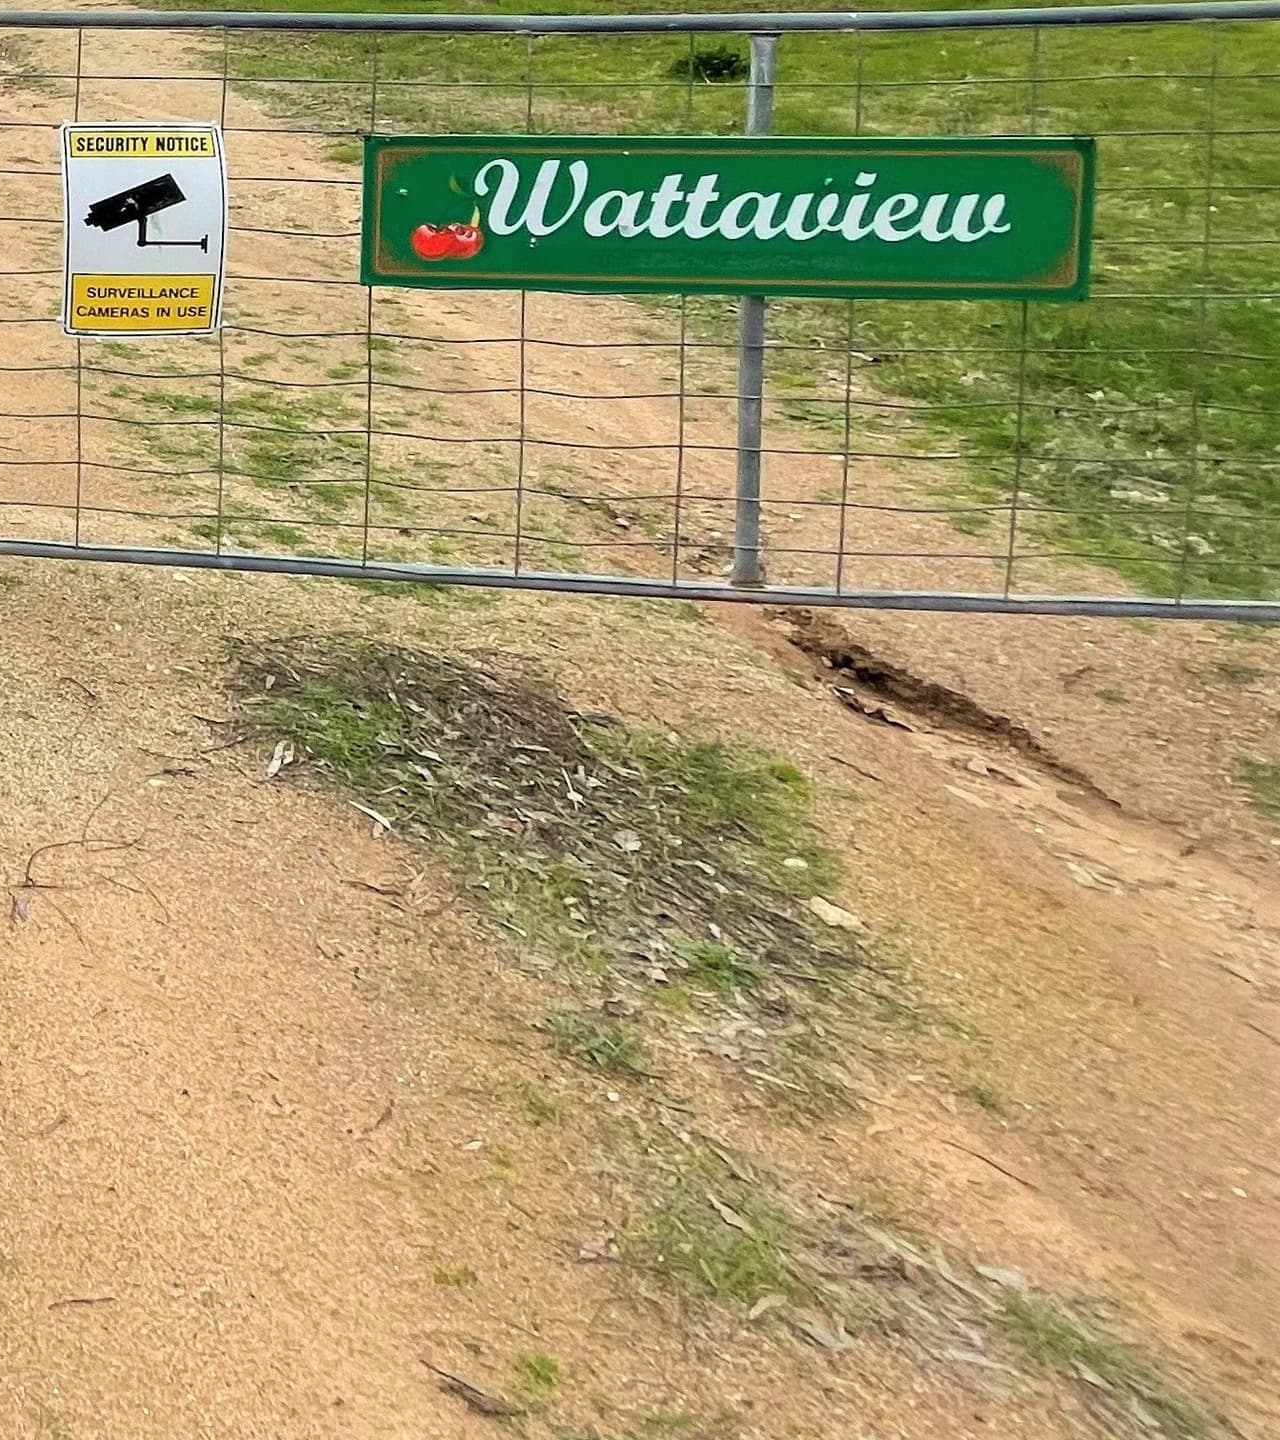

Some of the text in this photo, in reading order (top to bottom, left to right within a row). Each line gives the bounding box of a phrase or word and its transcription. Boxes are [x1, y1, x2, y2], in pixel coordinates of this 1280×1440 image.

[77, 137, 207, 152] SECURITY NOTICE
[473, 158, 1012, 243] Wattaview
[87, 287, 199, 299] SURVEILLANCE
[77, 306, 207, 318] CAMERAS IN USE
